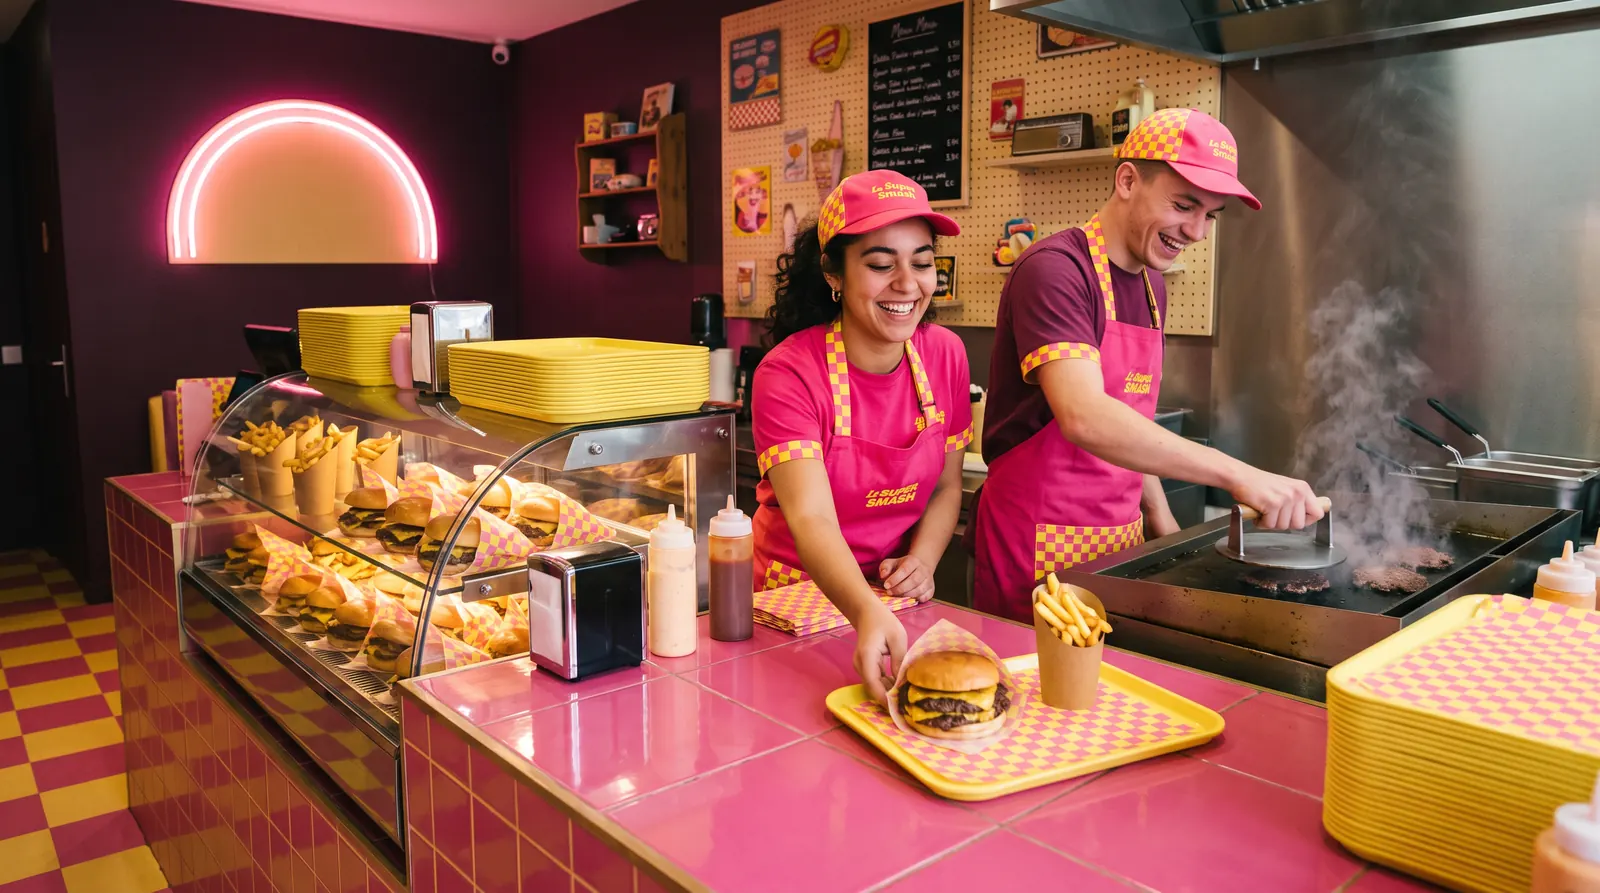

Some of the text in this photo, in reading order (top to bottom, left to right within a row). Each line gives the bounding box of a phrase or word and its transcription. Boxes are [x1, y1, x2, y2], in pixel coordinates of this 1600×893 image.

[1208, 139, 1220, 148] Le
[878, 191, 916, 200] Smash
[1124, 382, 1151, 394] SMASH
[879, 482, 919, 497] SUPER
[865, 492, 916, 507] SMASH
